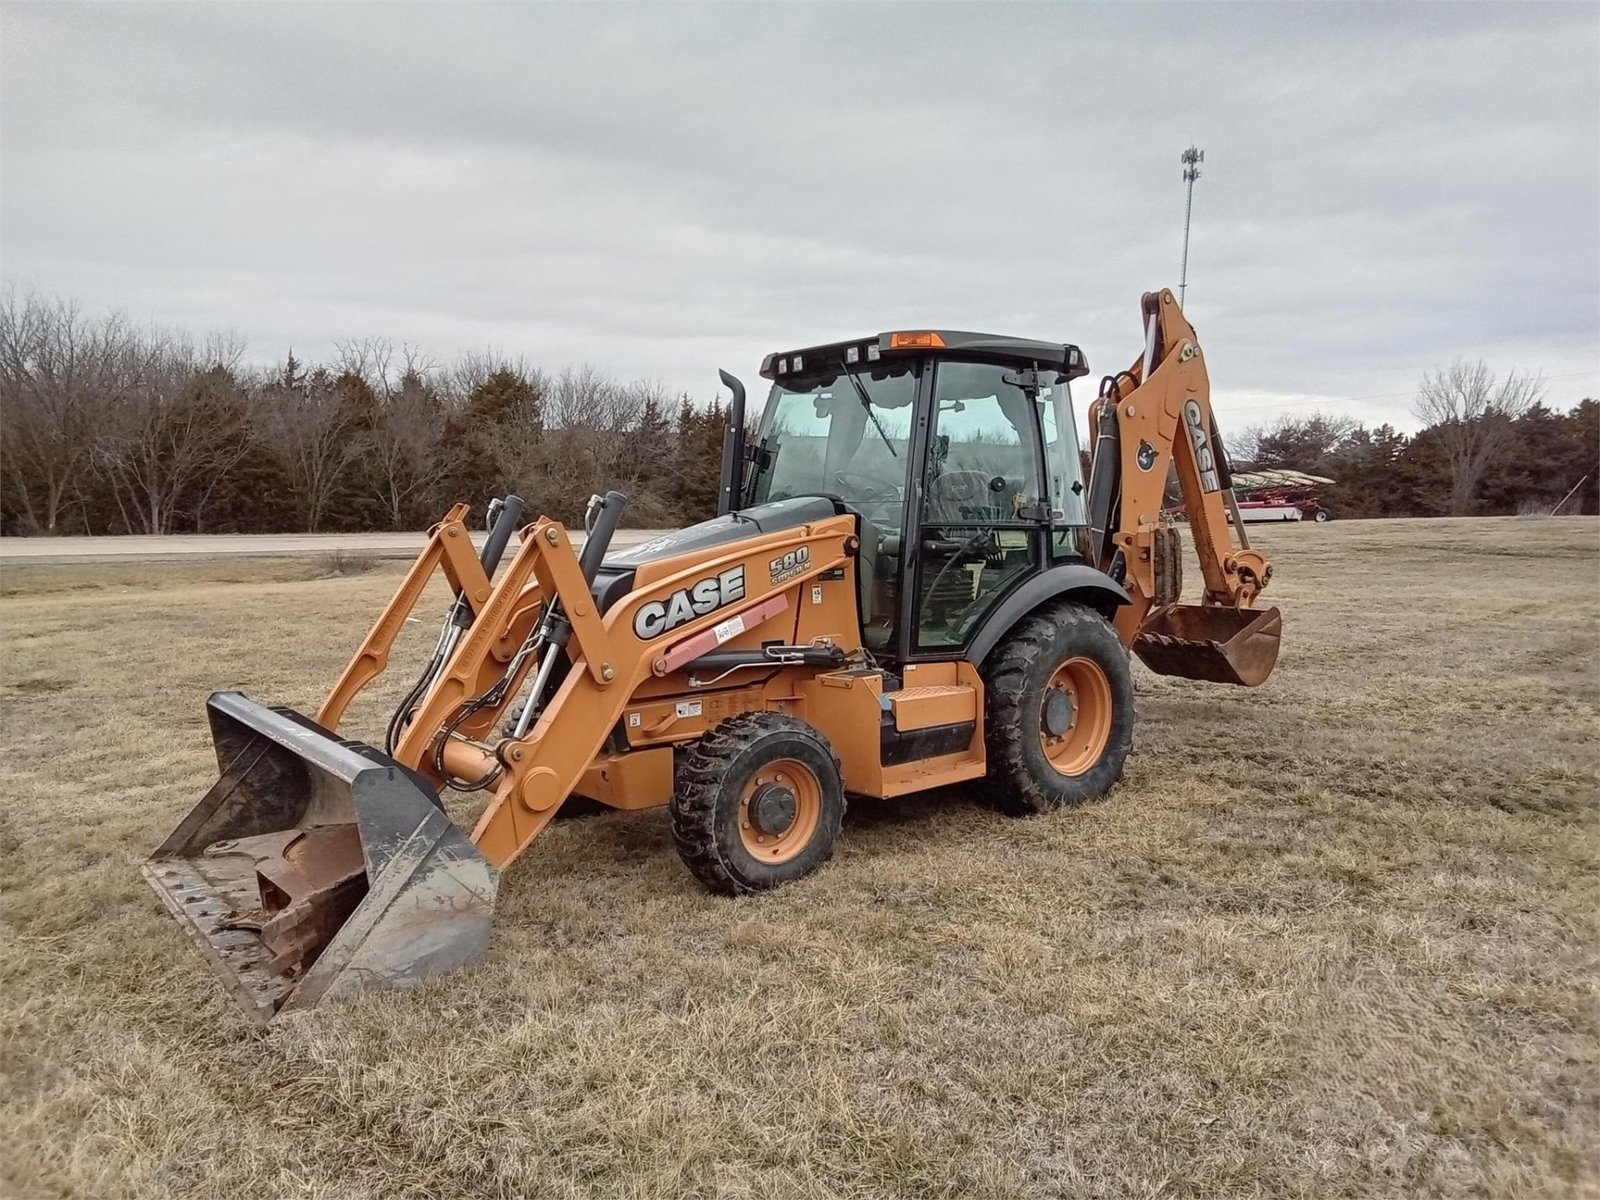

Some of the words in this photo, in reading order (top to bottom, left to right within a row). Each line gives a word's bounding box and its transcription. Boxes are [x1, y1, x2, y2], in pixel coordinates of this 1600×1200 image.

[1185, 399, 1219, 493] CASE
[769, 545, 809, 577] 580
[770, 564, 803, 586] SUPER
[632, 564, 745, 640] CASE
